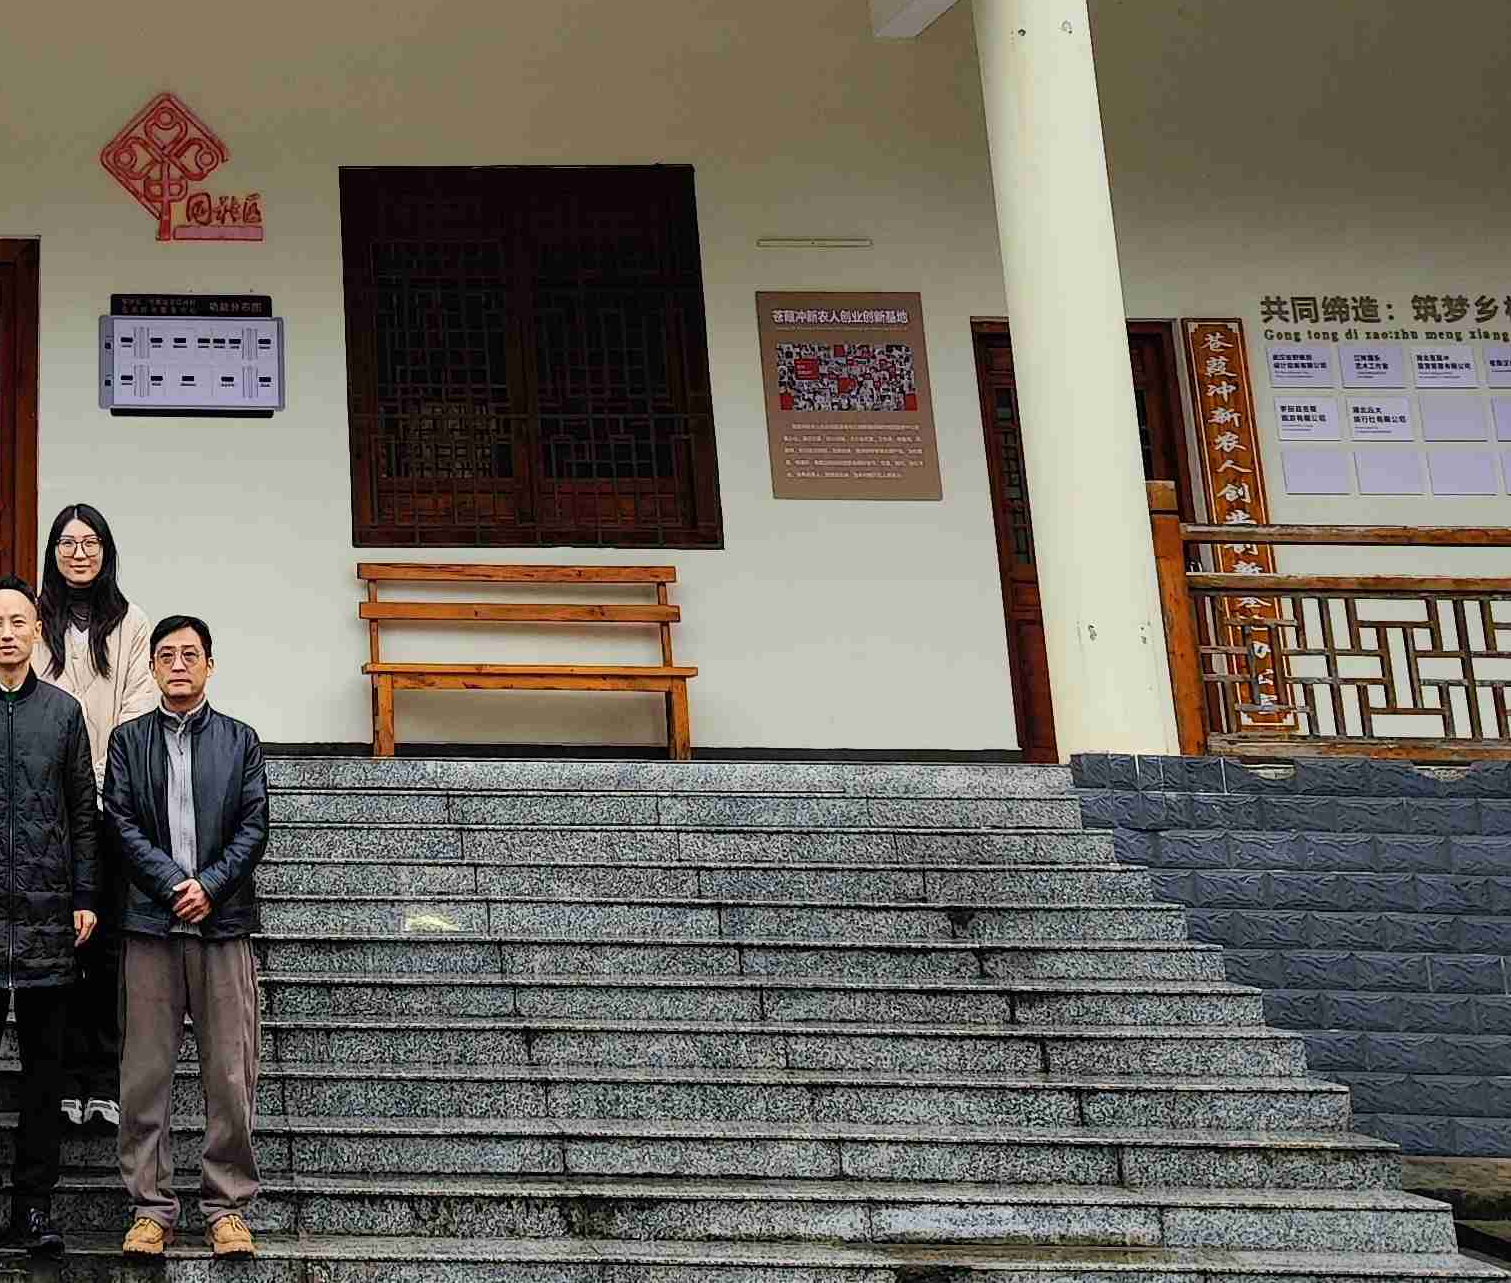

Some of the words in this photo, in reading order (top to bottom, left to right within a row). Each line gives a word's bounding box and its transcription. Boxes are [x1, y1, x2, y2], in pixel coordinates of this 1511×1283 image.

[1260, 294, 1511, 324] 共同缔造：筑梦乡
[1264, 329, 1301, 342] Gong
[1308, 329, 1339, 342] tong
[1346, 328, 1359, 340] di
[1426, 330, 1463, 342] meng
[1469, 328, 1511, 343] xiang
